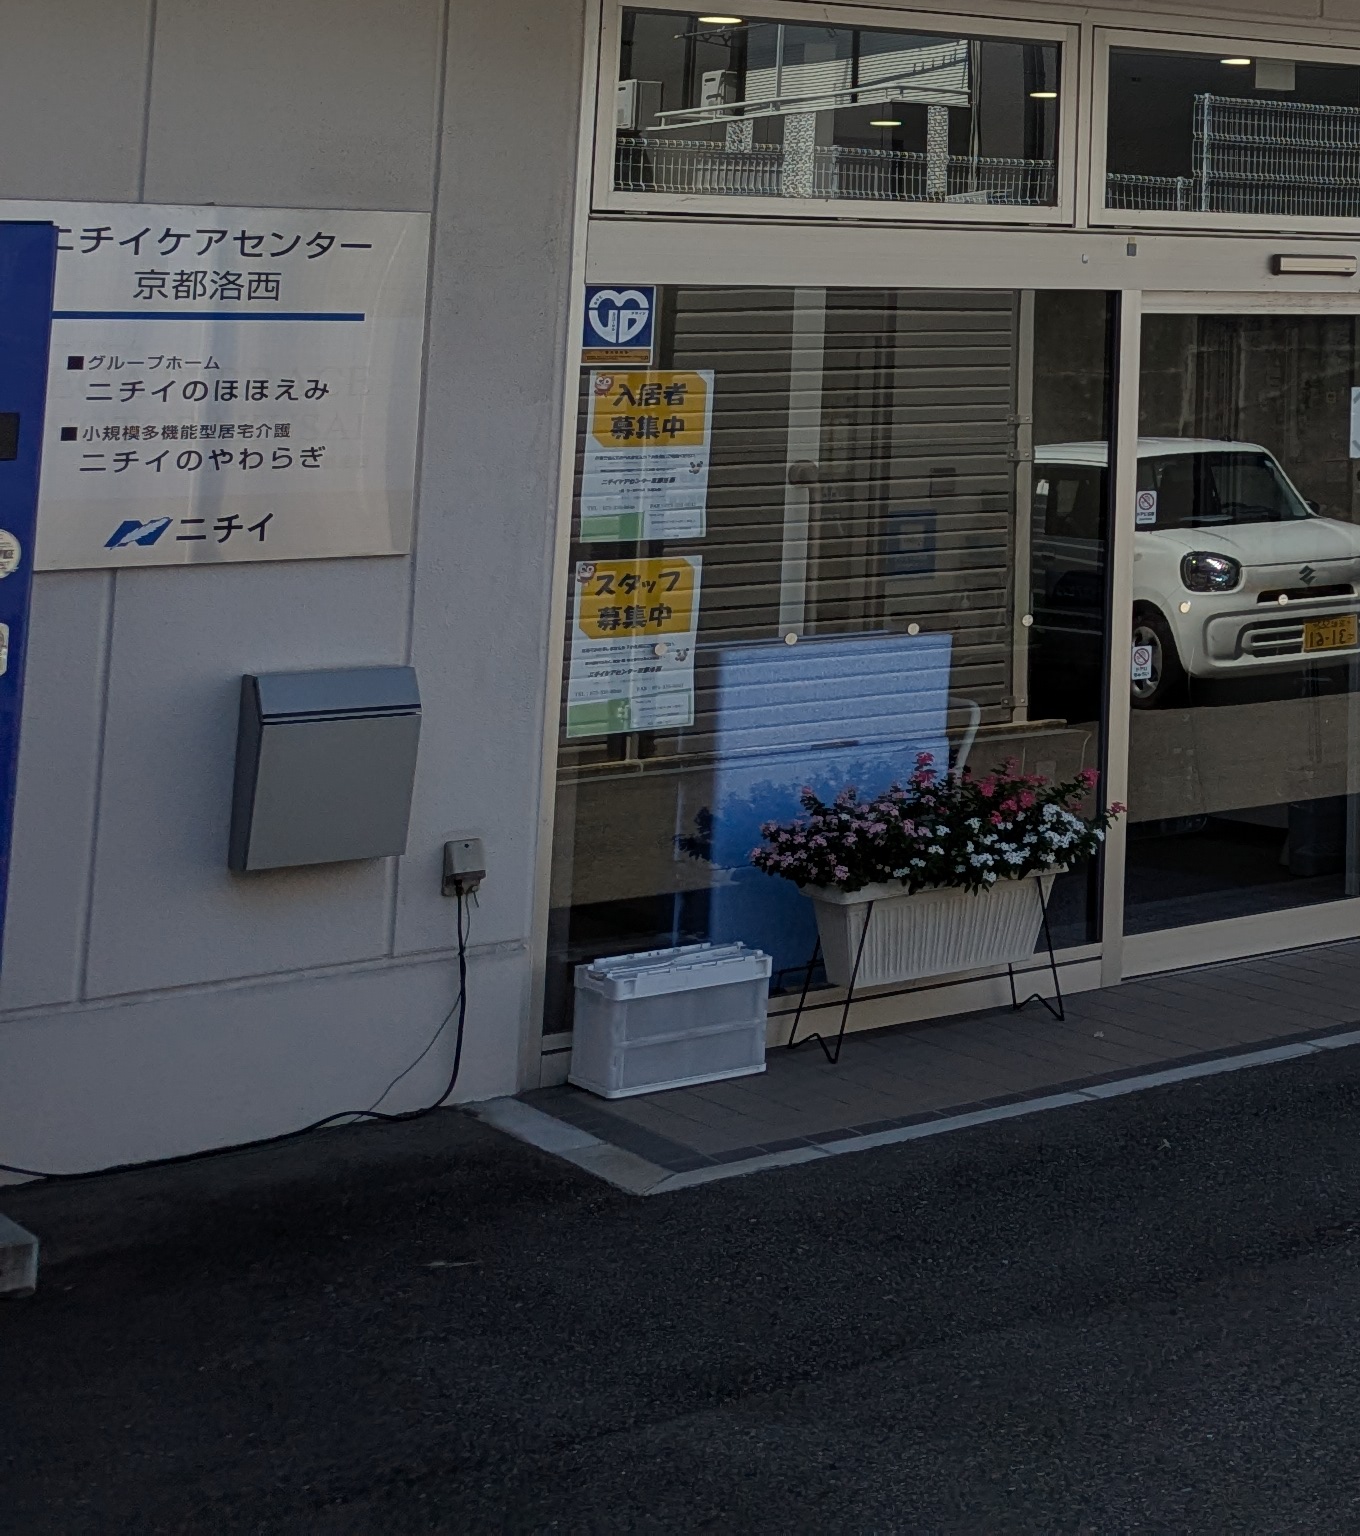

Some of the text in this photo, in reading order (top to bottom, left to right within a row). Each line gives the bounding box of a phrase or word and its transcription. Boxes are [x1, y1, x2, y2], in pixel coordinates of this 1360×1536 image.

[132, 268, 282, 302] 京都洛西
[87, 355, 221, 371] グループホーム
[85, 378, 330, 403] ニチイのほほえみ
[612, 382, 688, 407] 入居者
[82, 423, 291, 442] 小規模多機能型居宅介護
[610, 416, 686, 440] 募集中
[79, 446, 327, 474] ニチイのやわらぎ
[175, 512, 276, 544] ニチイ
[594, 570, 682, 597] スタッフ
[596, 603, 673, 630] 募集中
